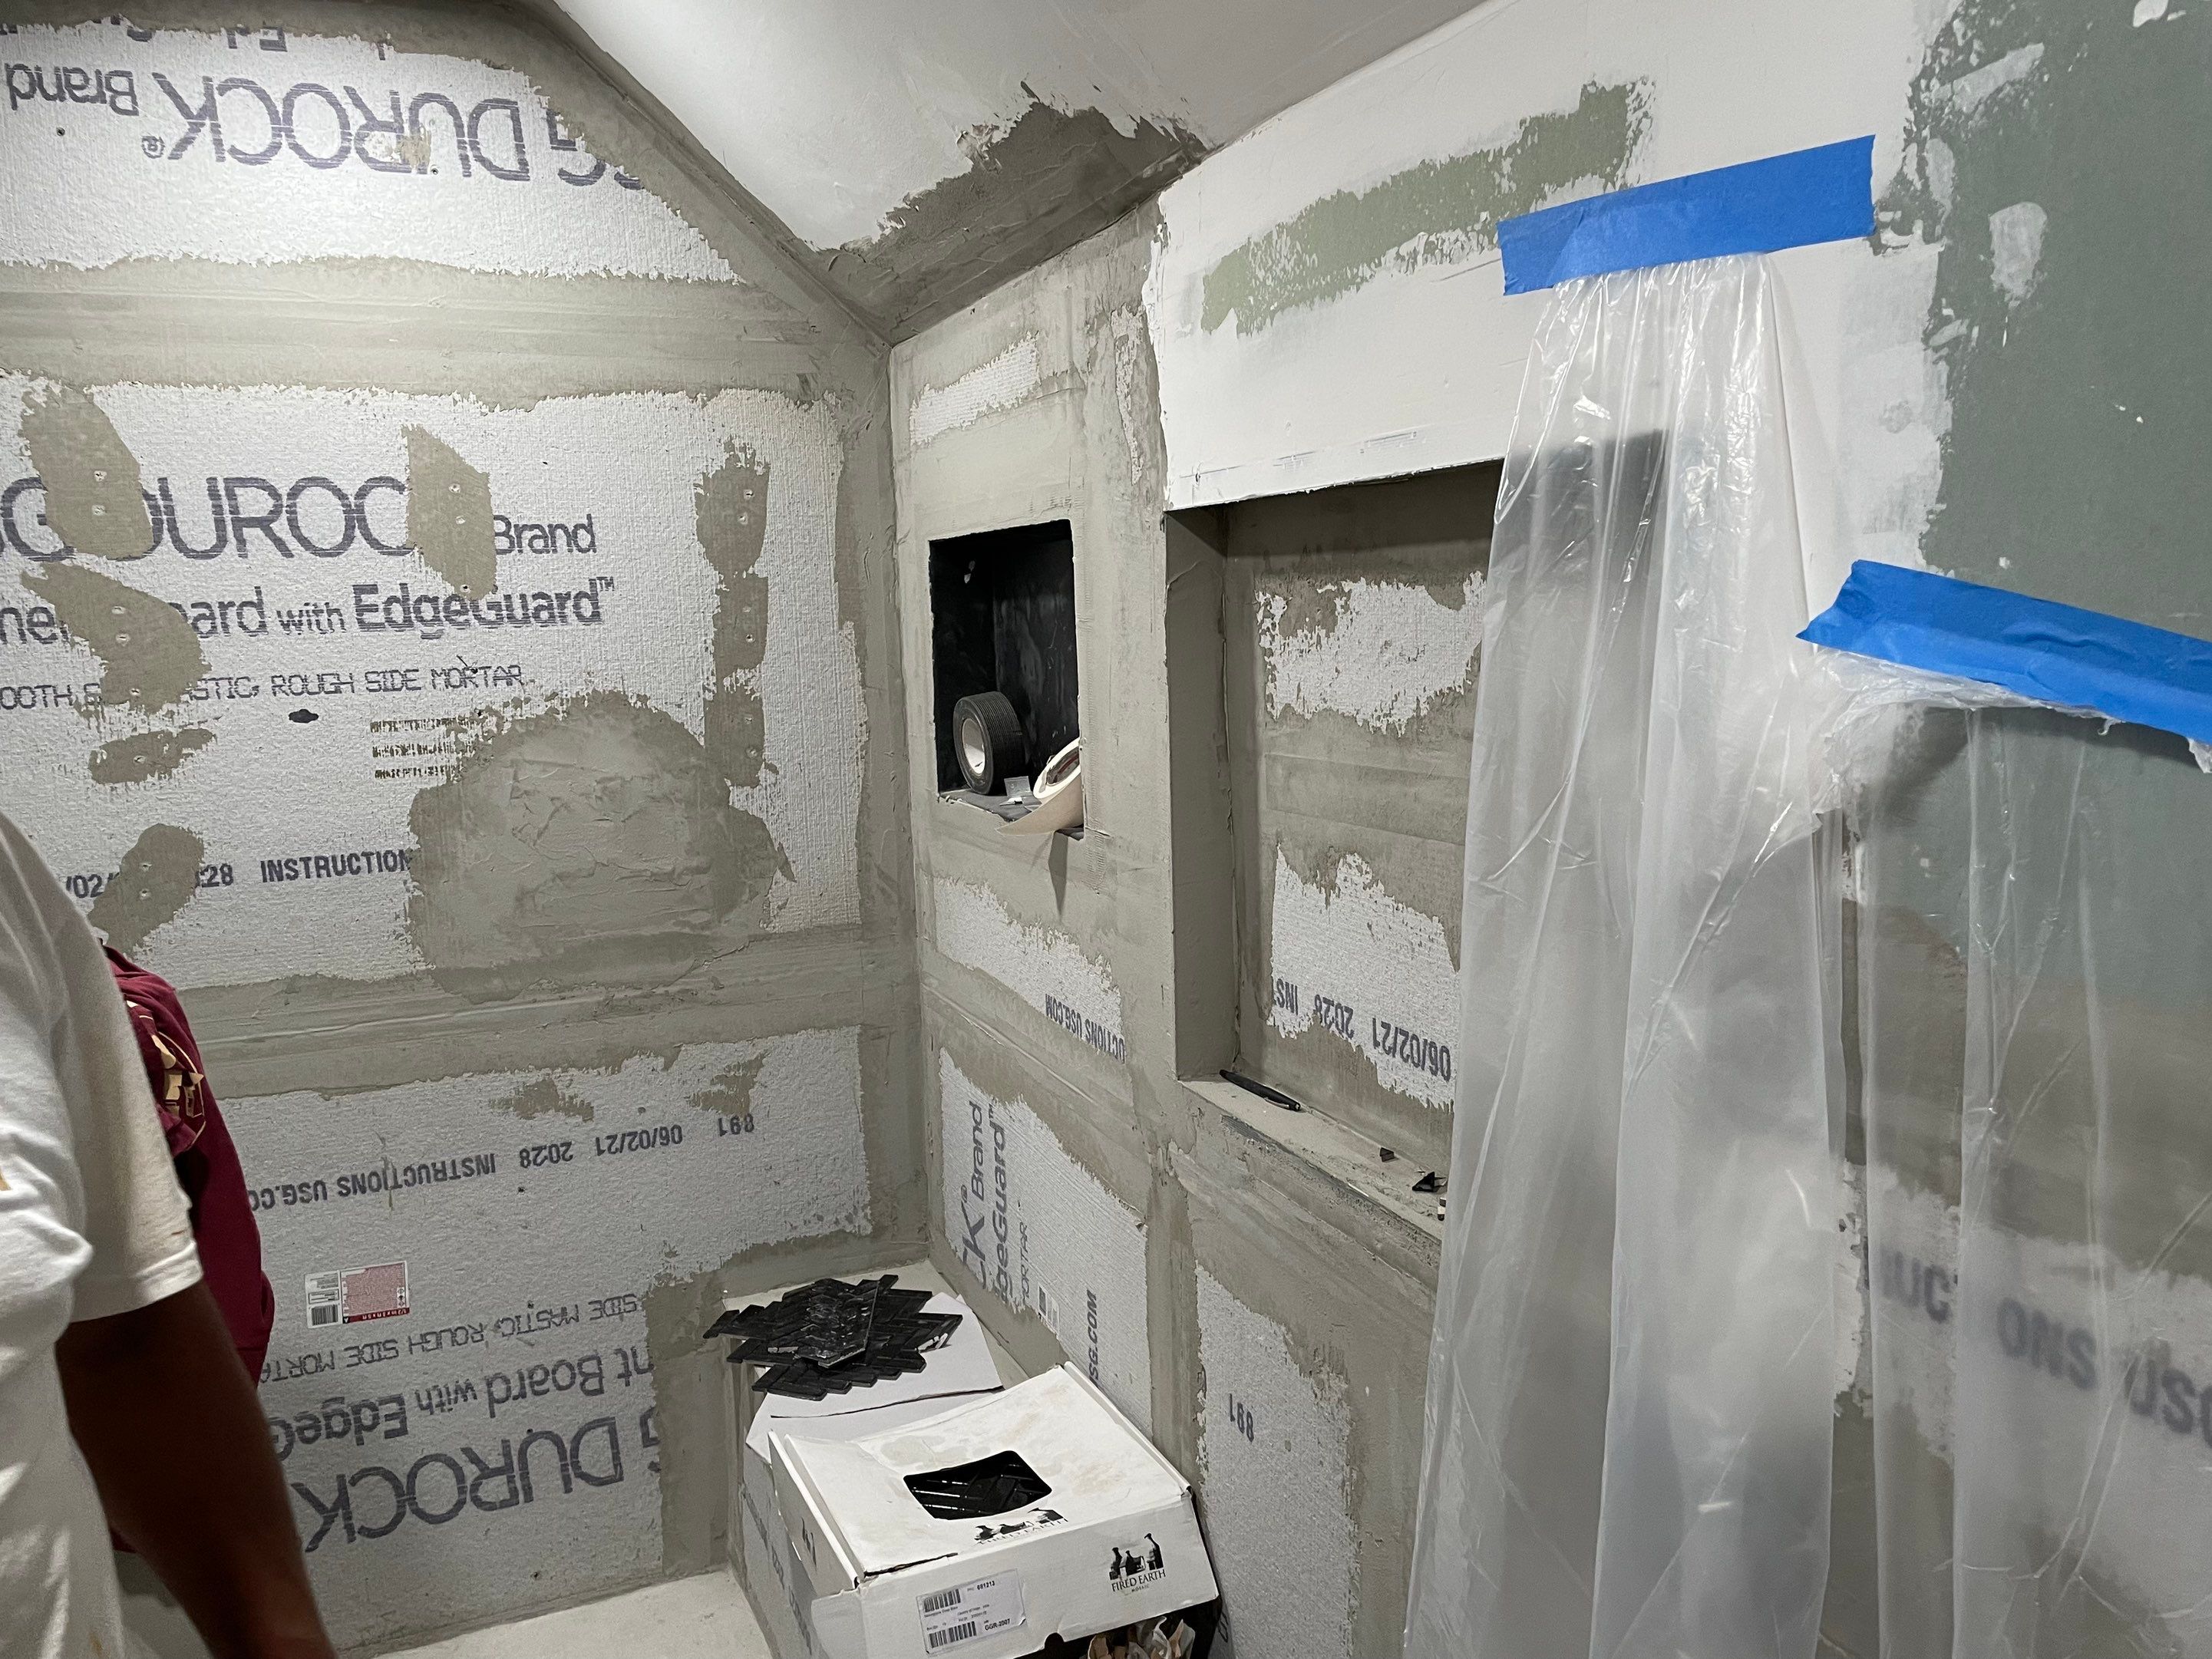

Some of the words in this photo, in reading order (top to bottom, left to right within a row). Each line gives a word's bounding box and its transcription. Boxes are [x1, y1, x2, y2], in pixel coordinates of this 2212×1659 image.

[5, 62, 140, 117] Brand
[493, 513, 597, 556] Brand
[276, 602, 346, 635] with
[0, 683, 74, 710] OOTH
[271, 672, 355, 698] ROUGH
[365, 668, 421, 694] SIDE
[431, 663, 525, 691] MORTAR
[260, 849, 411, 883] INSTRUCTION
[1045, 993, 1082, 1040] USG.COM
[1371, 1017, 1452, 1083] 06/02/21
[595, 1124, 683, 1156] 06/02/21
[718, 1113, 755, 1137] 891
[519, 1140, 574, 1169] 2028
[969, 1100, 985, 1202] Brand
[335, 1153, 497, 1198] INSTRUCTIONS
[249, 1179, 328, 1212] USG.CO
[588, 1293, 638, 1321] SIDE
[343, 1338, 399, 1367] SIDE
[408, 1323, 485, 1355] ROUGH
[259, 1350, 335, 1384] MORTA
[414, 1378, 478, 1415] with
[484, 1354, 606, 1419] Board
[1229, 1393, 1255, 1443] 891
[1138, 1568, 1167, 1585] EARTH
